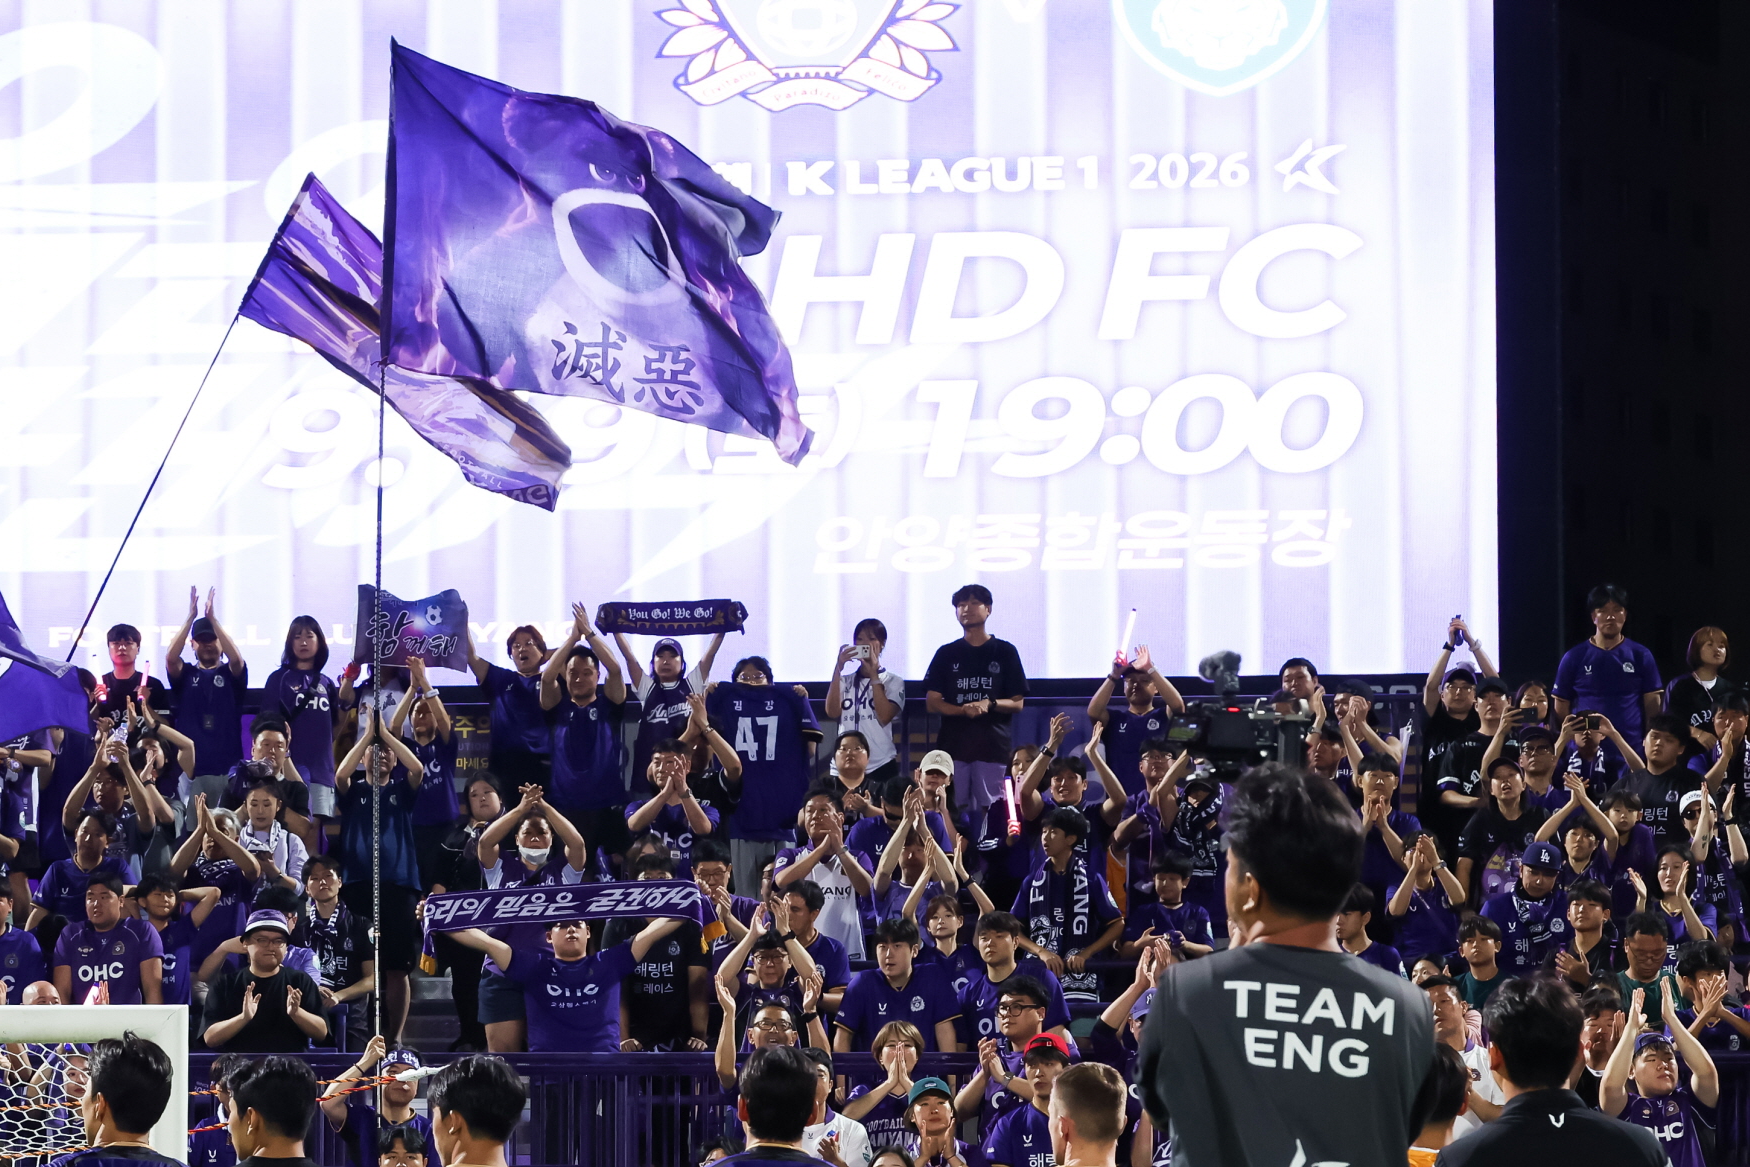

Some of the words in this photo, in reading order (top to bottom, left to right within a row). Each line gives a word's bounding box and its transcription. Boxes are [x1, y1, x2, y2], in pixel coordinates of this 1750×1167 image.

[787, 160, 834, 196] K
[850, 155, 1065, 195] LEAGUE
[1129, 152, 1250, 191] 2026
[769, 230, 1066, 346] HD
[1098, 223, 1365, 342] FC
[551, 320, 705, 415] 滅惡
[923, 371, 1365, 482] 19:00
[813, 508, 1352, 576] 안양종합운동장
[956, 676, 993, 690] 해링턴
[736, 715, 779, 762] 47
[1638, 806, 1669, 822] 링턴
[1540, 848, 1552, 864] LA
[495, 889, 575, 918] 믿음은
[586, 885, 702, 913] 굳건하다
[821, 885, 852, 897] YANG
[77, 962, 125, 982] OHC
[634, 961, 674, 978] 해링턴
[1223, 980, 1395, 1037] TEAM
[1243, 1028, 1370, 1078] ENG
[869, 1130, 919, 1147] ANYAN
[1654, 1121, 1685, 1143] HC
